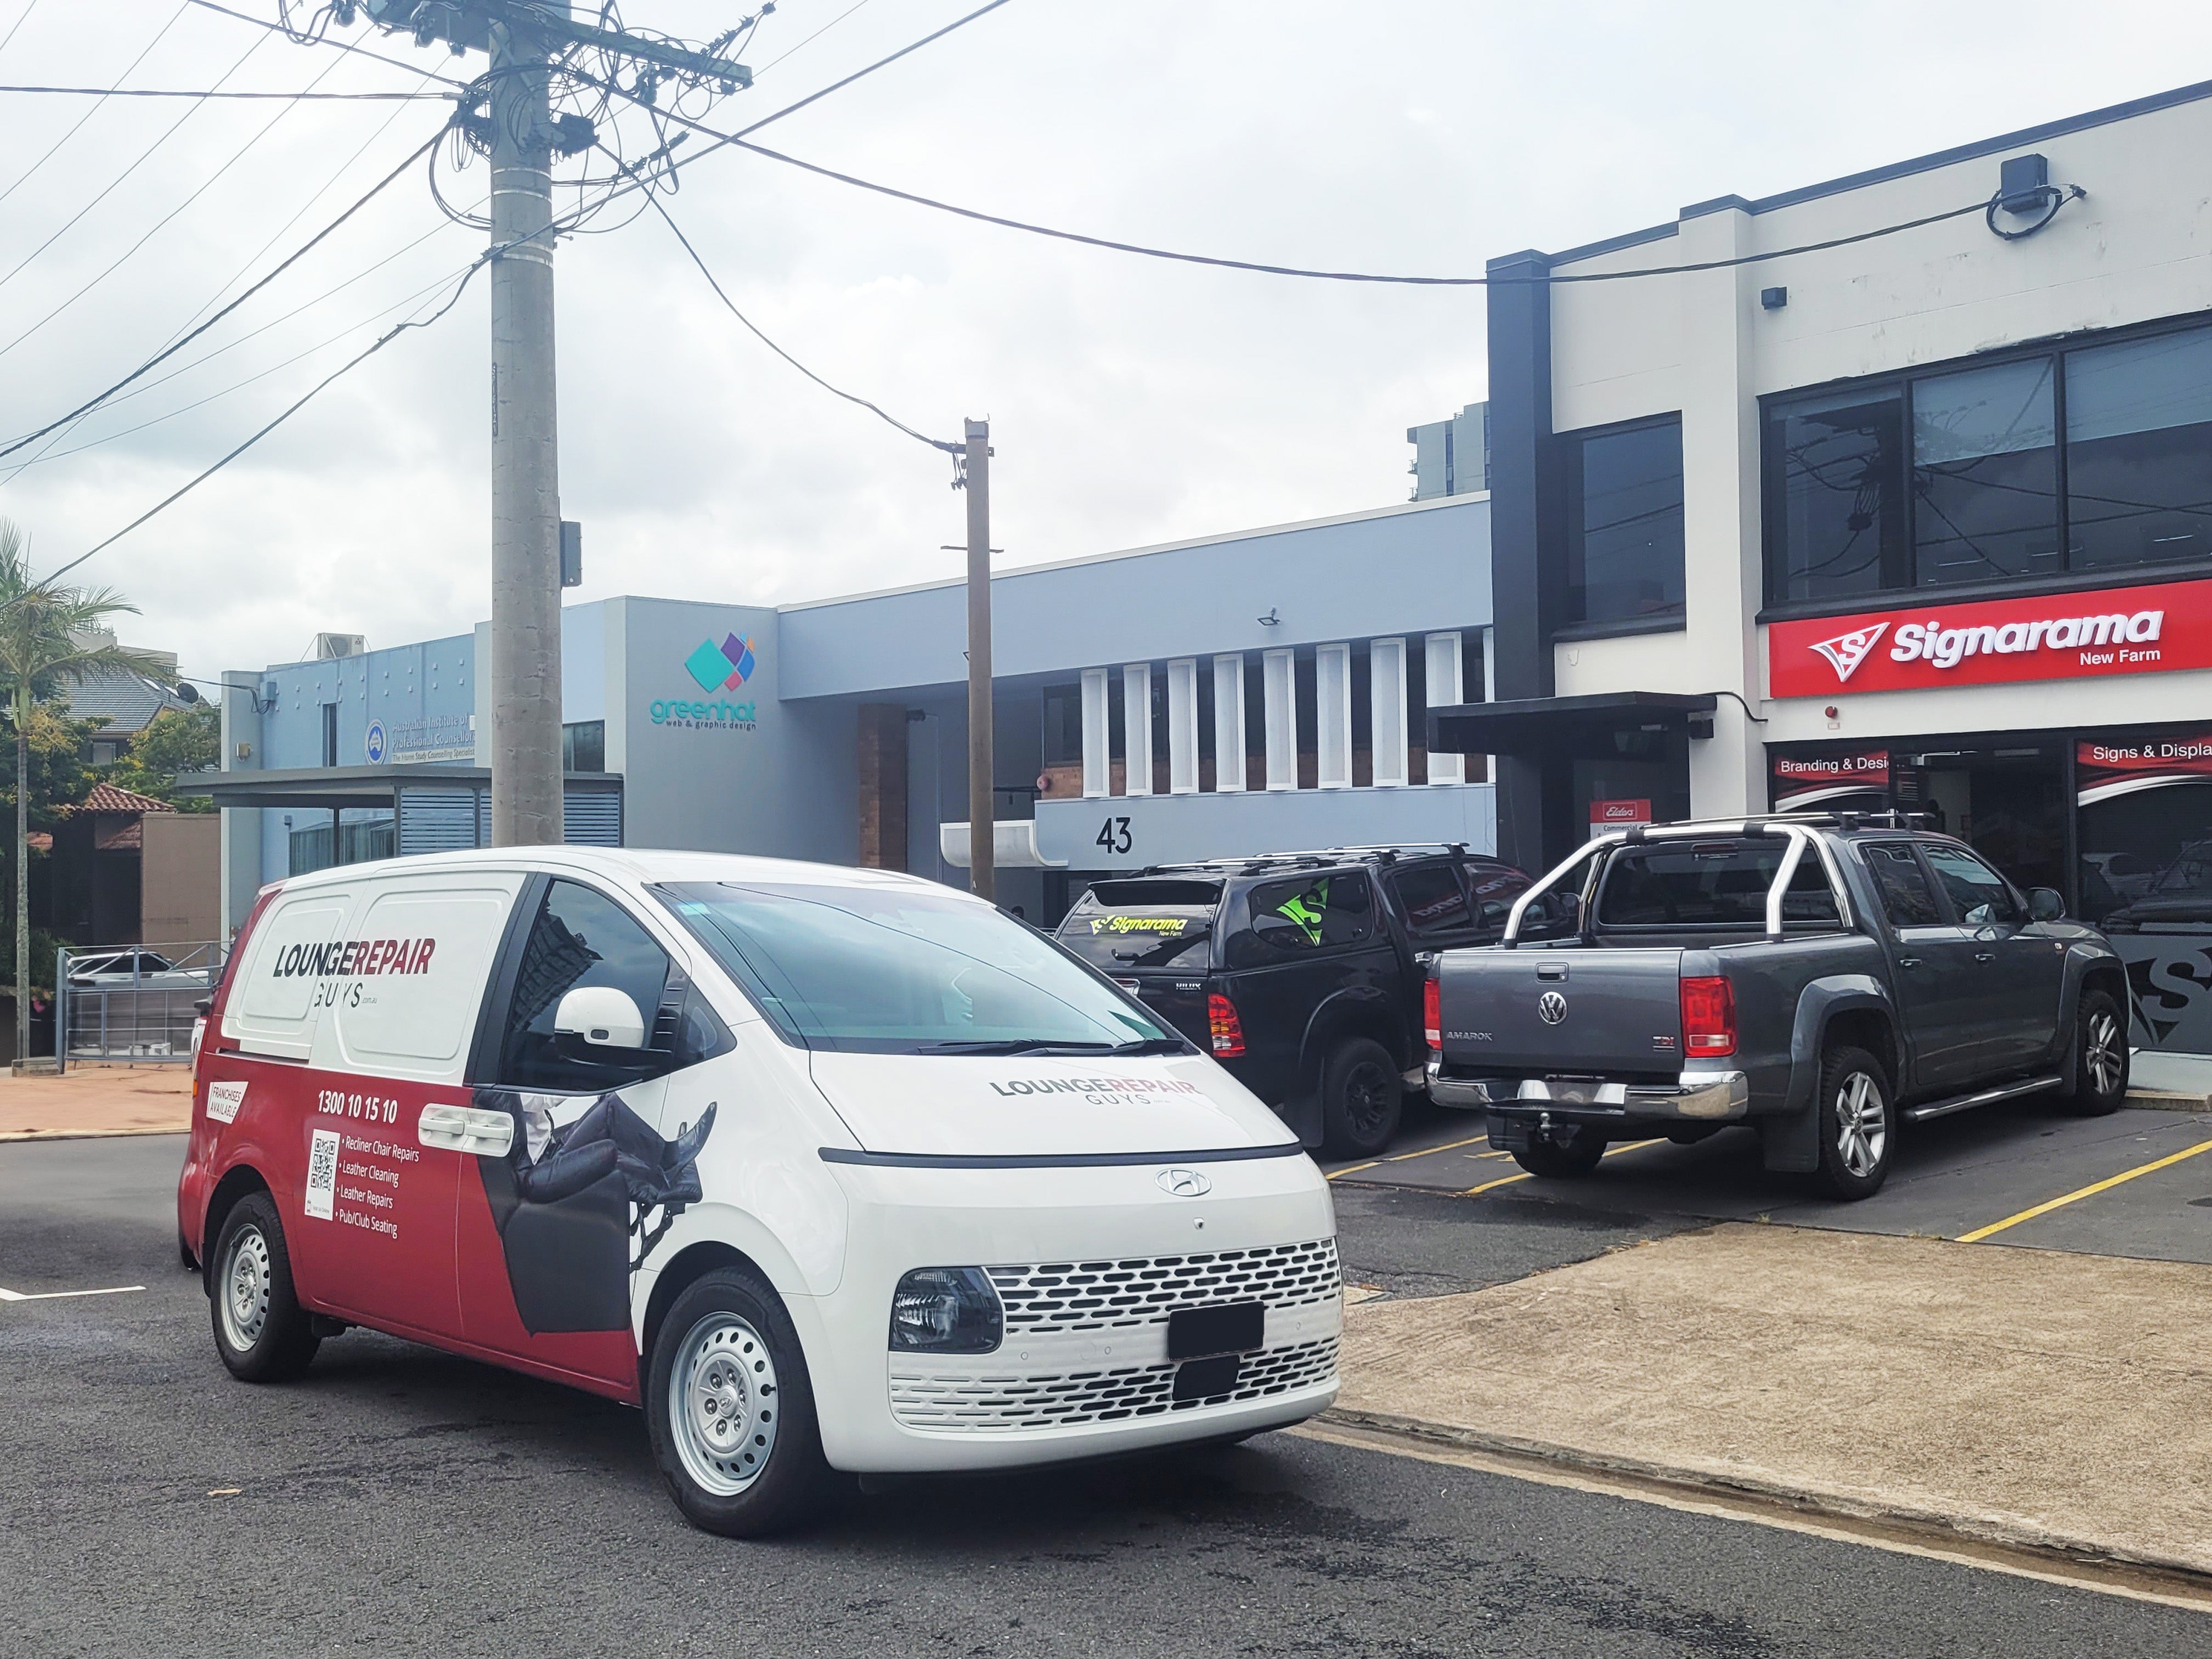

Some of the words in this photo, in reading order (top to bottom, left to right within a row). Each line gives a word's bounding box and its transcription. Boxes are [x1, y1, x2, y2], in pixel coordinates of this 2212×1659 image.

[1890, 611, 2164, 668] Signarama
[2080, 651, 2113, 666] New
[2119, 648, 2161, 664] Farm
[651, 698, 756, 724] greenhat
[393, 719, 427, 732] Australian
[429, 715, 458, 729] Institute
[460, 713, 469, 725] of
[696, 721, 727, 730] graphic
[730, 722, 757, 731] design
[392, 733, 433, 751] Professional
[2093, 747, 2138, 763] Signs
[2143, 744, 2155, 758] &
[2161, 742, 2212, 760] Displa
[1781, 759, 1838, 773] Branding
[1843, 758, 1853, 770] &
[1857, 756, 1888, 769] Desi
[1606, 806, 1634, 817] Elders
[1096, 817, 1132, 854] 43
[1109, 916, 1188, 934] Signarama
[273, 938, 436, 978] LOUNGEREPAIR
[314, 982, 363, 1008] GUYS
[1447, 1031, 1492, 1041] AMAROK
[213, 1086, 241, 1103] FRANCHISES
[989, 1079, 1203, 1097] LOUNGEREPAIR
[318, 1090, 345, 1115] 1300
[348, 1094, 362, 1118] 10
[365, 1096, 380, 1121] 15
[382, 1099, 398, 1124] 10
[1085, 1094, 1151, 1105] GUYS
[210, 1101, 236, 1118] AVAILABLE
[346, 1135, 373, 1154] Recliner
[373, 1140, 392, 1157] Chair
[392, 1144, 420, 1163] Repairs
[342, 1160, 368, 1177] Leather
[369, 1166, 399, 1188] Cleaning
[341, 1184, 366, 1203] Leather
[367, 1189, 393, 1209] Repairs
[340, 1209, 370, 1229] Pub/Club
[371, 1216, 398, 1239] Seating
